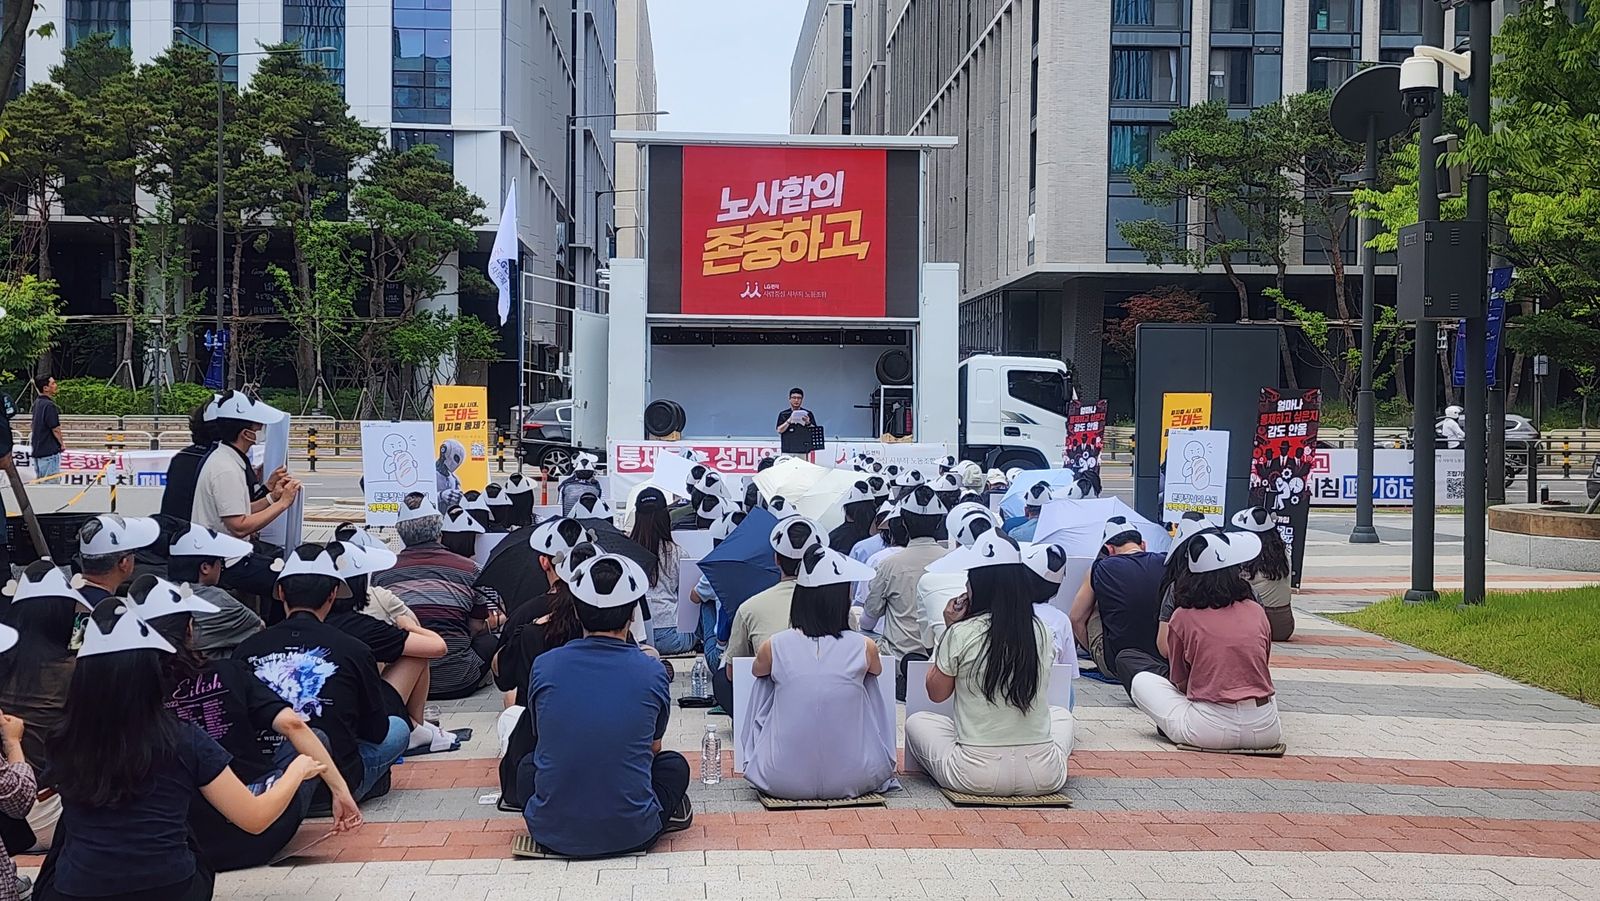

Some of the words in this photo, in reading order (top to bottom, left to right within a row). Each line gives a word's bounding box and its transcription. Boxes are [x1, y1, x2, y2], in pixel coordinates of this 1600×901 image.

[716, 170, 845, 222] 노사합의
[702, 209, 870, 276] 존중하고
[1277, 398, 1304, 412] 얼마나
[444, 408, 479, 421] 근태는
[1171, 414, 1203, 426] 근태는
[1260, 412, 1292, 425] 통제하고
[1293, 410, 1319, 422] 싶은지
[437, 422, 462, 432] 피지컬
[464, 421, 486, 430] 통제?
[1267, 425, 1286, 438] 감도
[172, 673, 223, 700] Eilish
